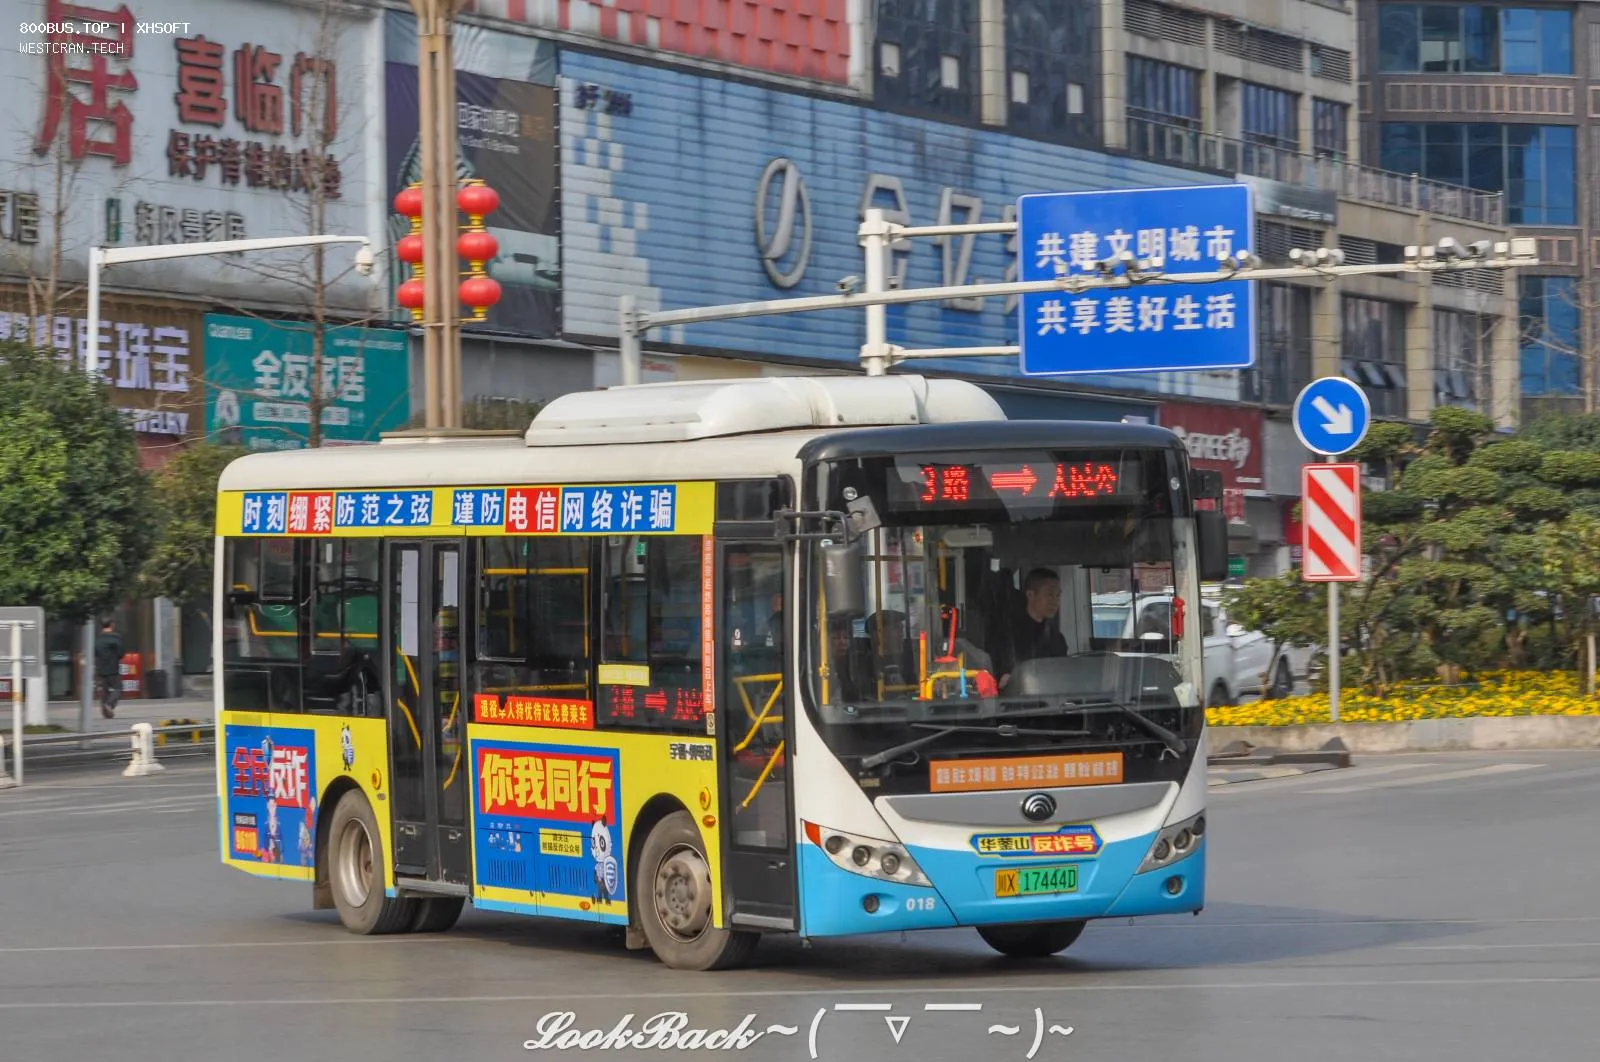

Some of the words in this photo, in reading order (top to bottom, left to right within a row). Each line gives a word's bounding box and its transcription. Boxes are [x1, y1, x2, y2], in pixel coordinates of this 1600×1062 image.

[174, 34, 338, 143] 喜临门
[1036, 225, 1236, 270] 共建文明城市
[1036, 293, 1237, 336] 共享美好生活
[244, 493, 431, 533] 时刻绷紧防范之弦
[453, 488, 673, 532] 谨防电信网络诈骗
[480, 753, 613, 815] 你我同行
[905, 897, 935, 911] 018
